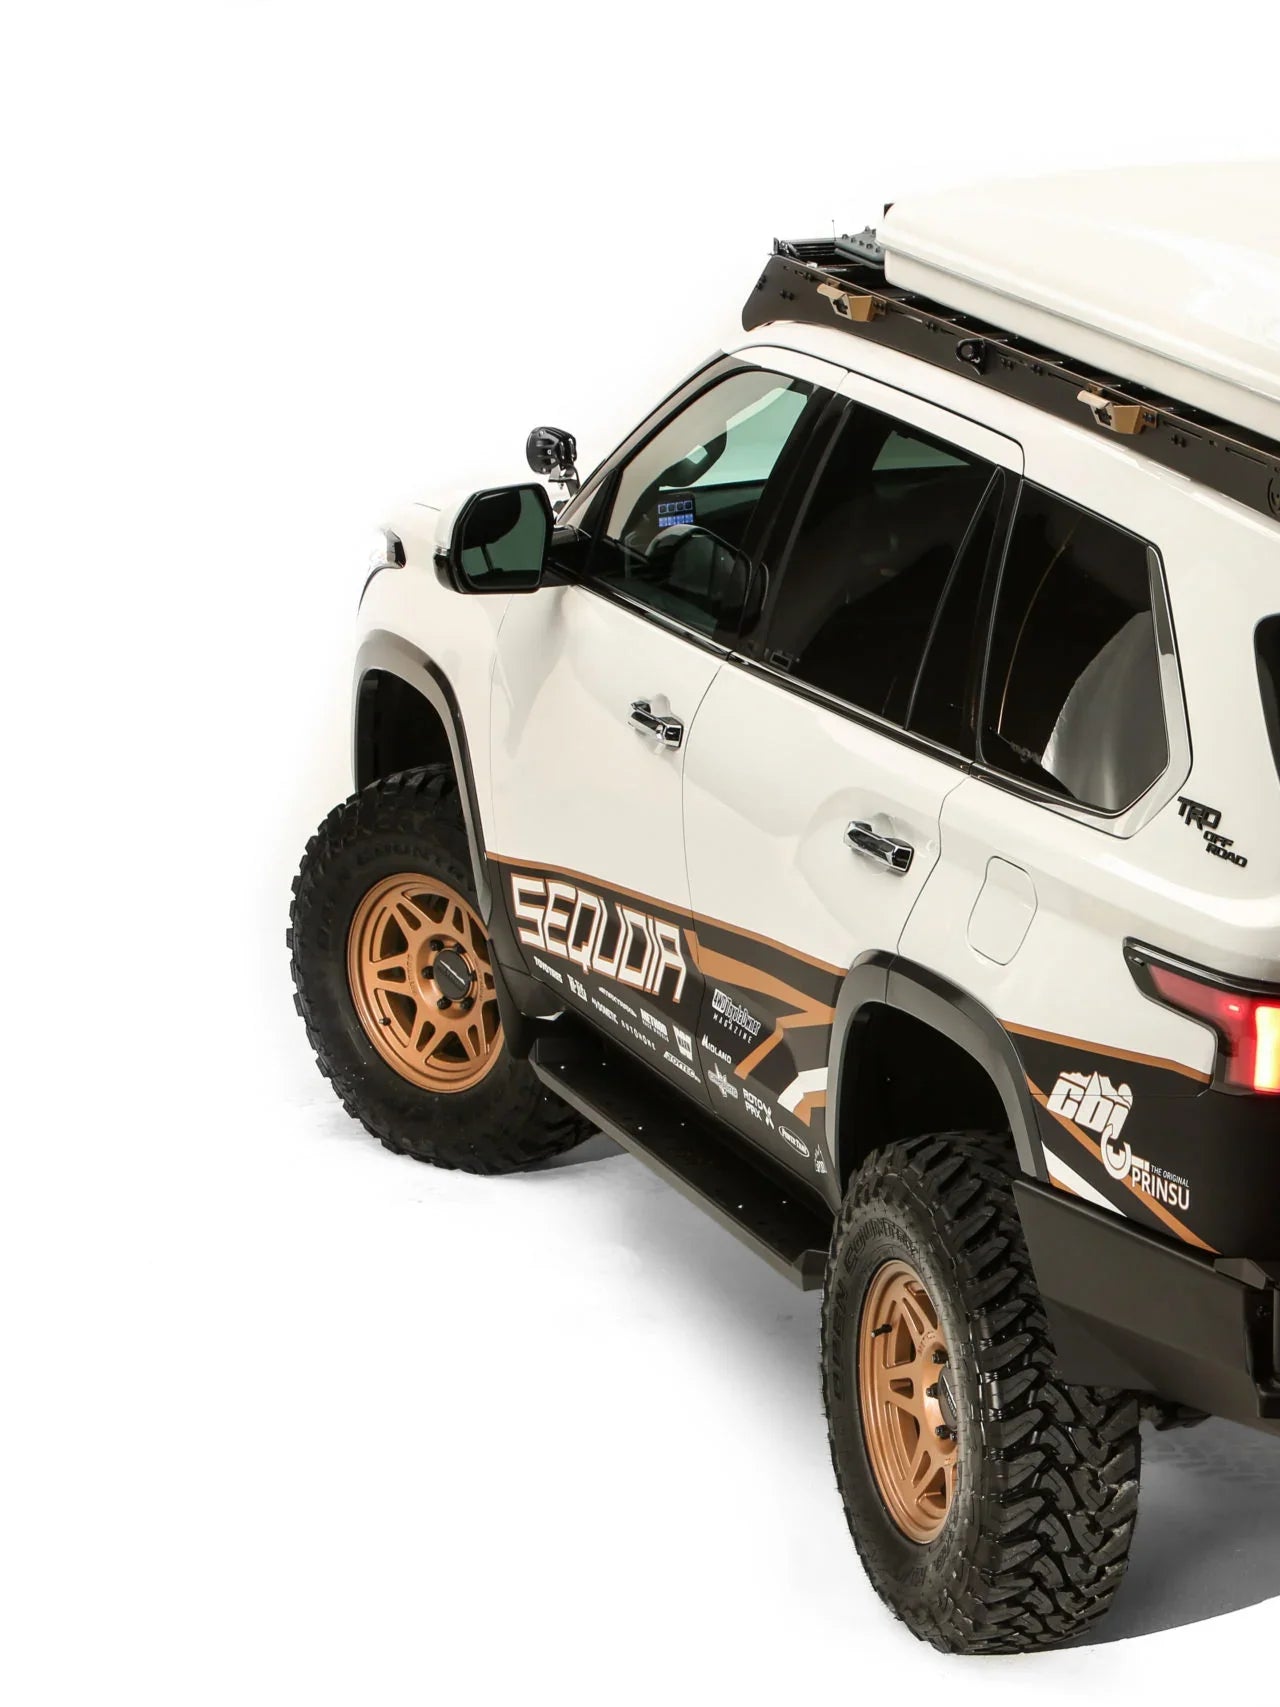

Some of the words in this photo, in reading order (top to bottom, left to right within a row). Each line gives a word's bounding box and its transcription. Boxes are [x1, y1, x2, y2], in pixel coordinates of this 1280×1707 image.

[1177, 796, 1222, 830] TRD
[1203, 830, 1234, 847] OFF
[1206, 842, 1248, 868] ROAD
[510, 872, 687, 1004] SEQUOIA
[713, 1012, 752, 1044] MAGAZINE
[1131, 1166, 1190, 1211] PRINSU
[1150, 1165, 1162, 1176] THE
[1162, 1170, 1190, 1188] ORIGINAL
